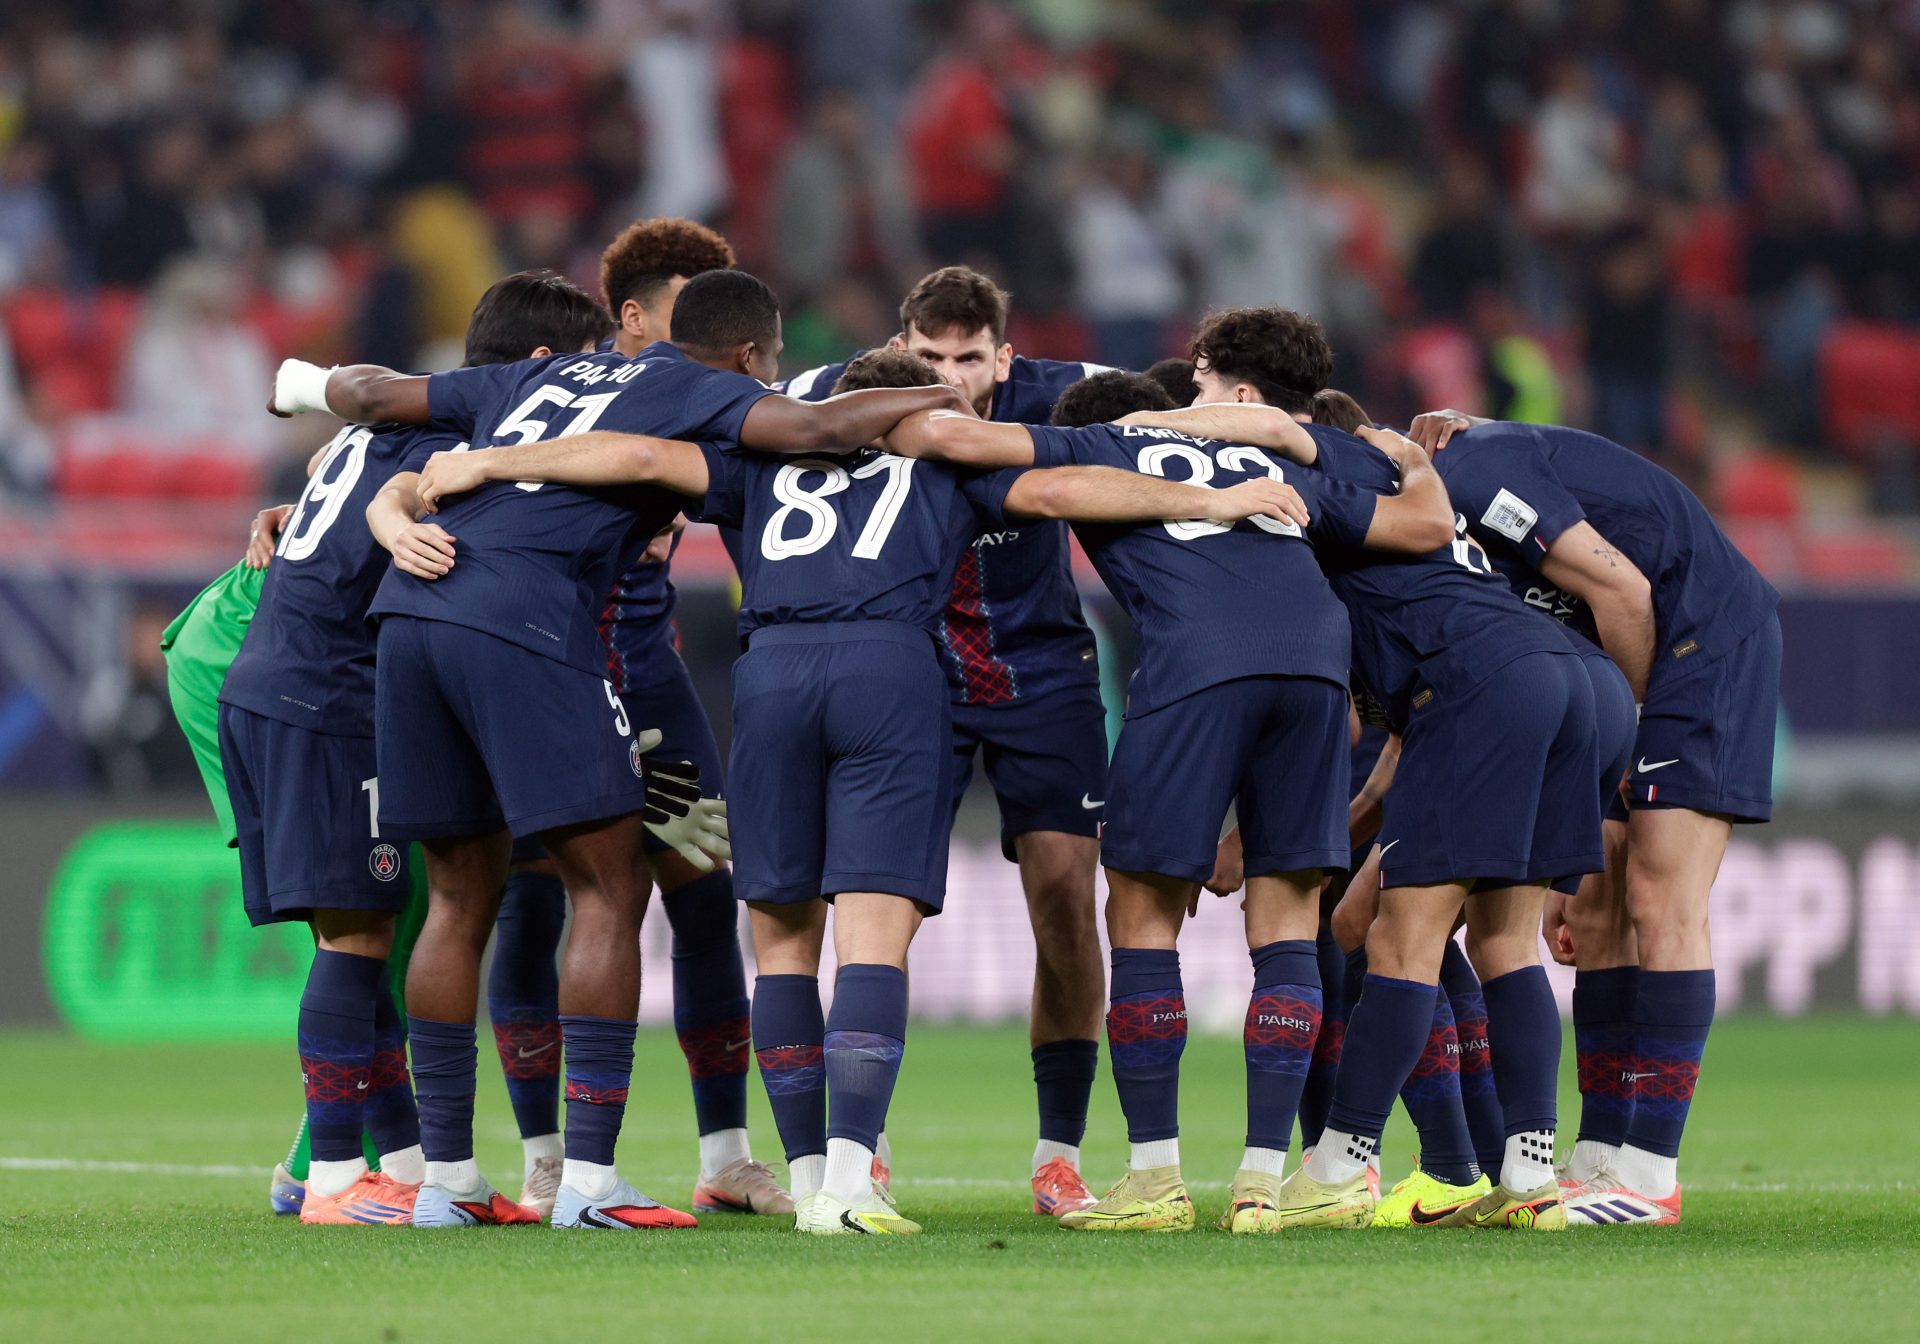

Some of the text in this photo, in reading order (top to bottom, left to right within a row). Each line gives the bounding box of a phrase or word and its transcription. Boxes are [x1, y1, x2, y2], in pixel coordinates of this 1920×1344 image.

[276, 424, 374, 560] 19
[761, 455, 917, 560] 87
[1258, 1014, 1311, 1032] PARIS
